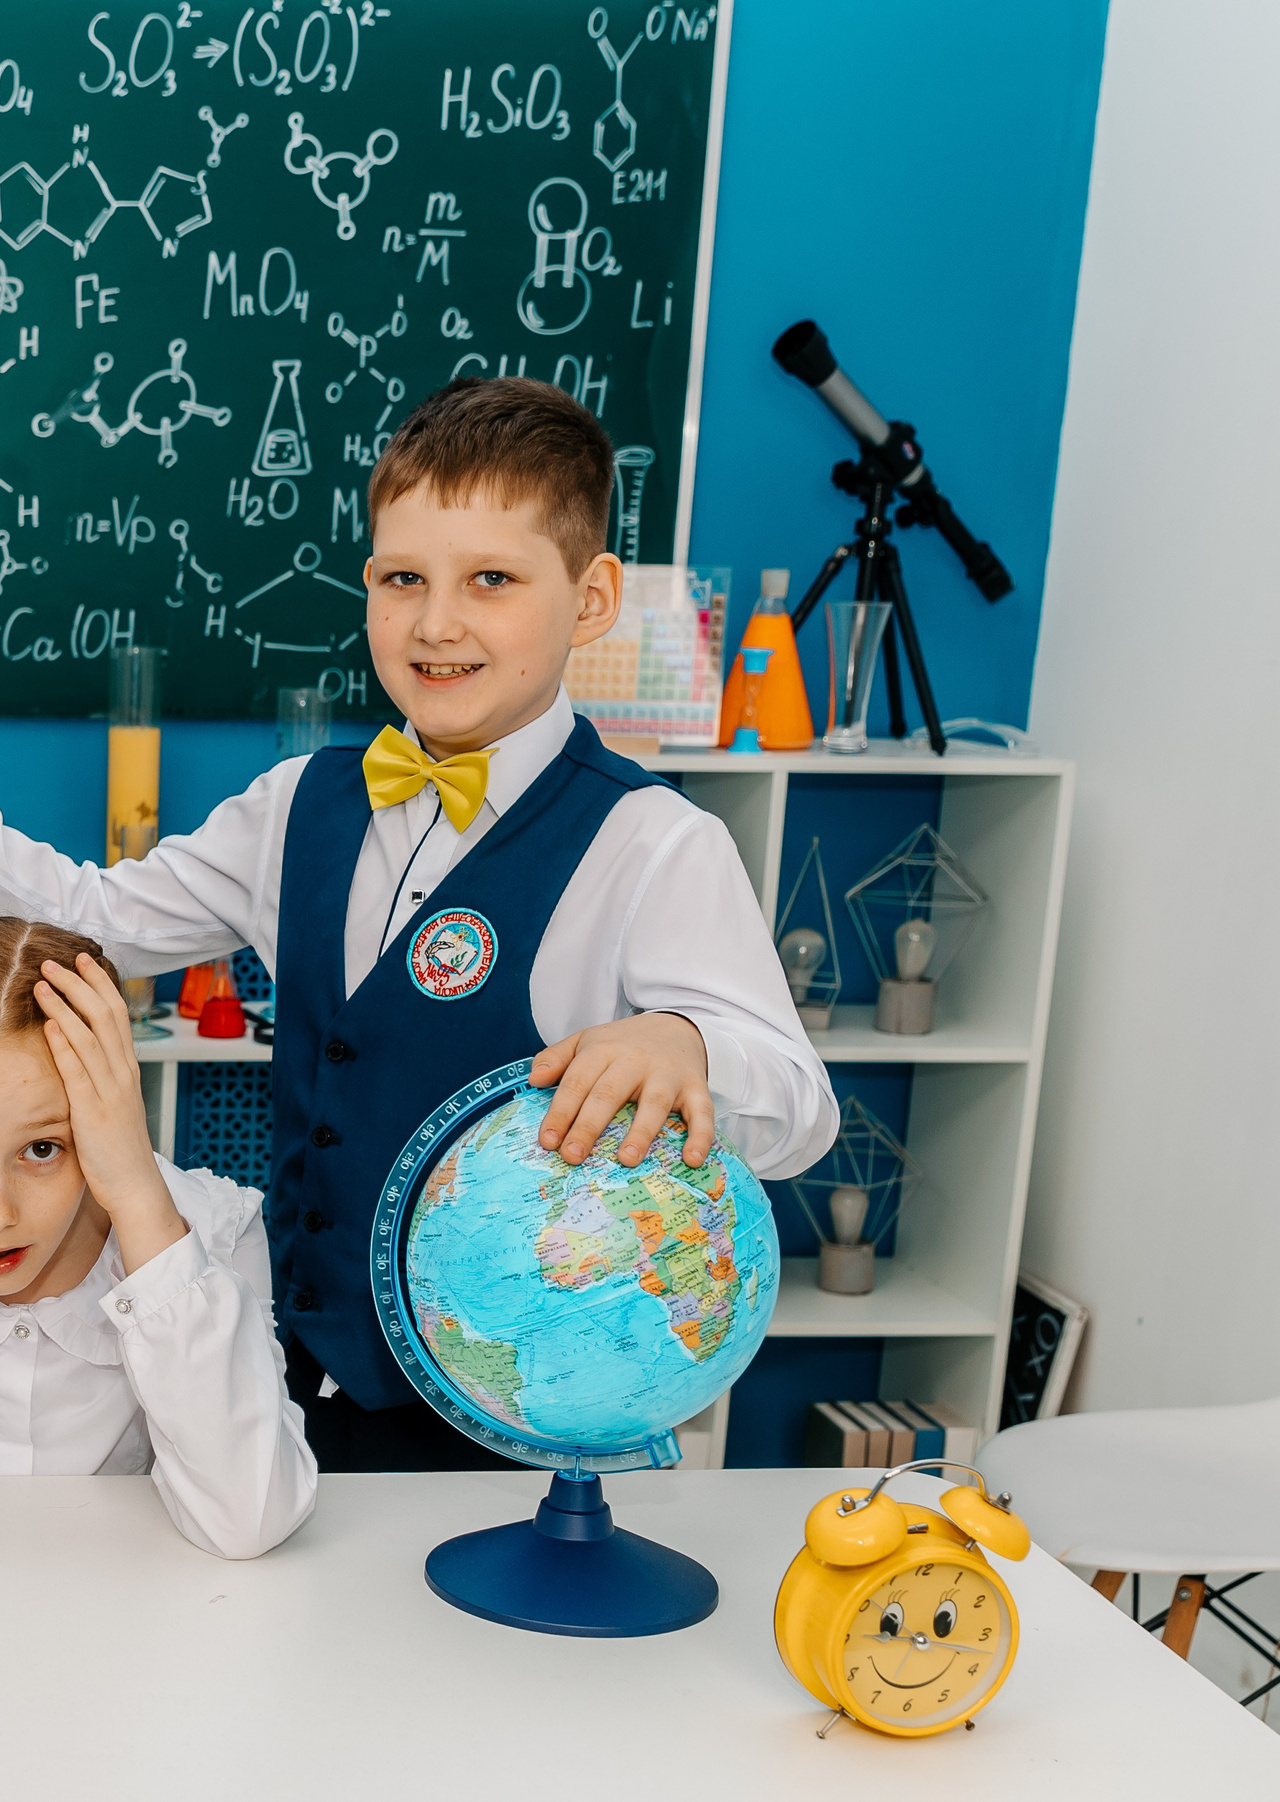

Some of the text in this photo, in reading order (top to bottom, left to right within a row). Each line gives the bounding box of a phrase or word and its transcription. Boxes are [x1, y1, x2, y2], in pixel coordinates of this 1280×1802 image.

[204, 247, 309, 323] MnO4
[75, 273, 120, 329] FE
[631, 280, 674, 328] Li
[440, 306, 474, 340] O2
[19, 326, 39, 360] H
[18, 495, 39, 528] H
[227, 477, 299, 526] H2O
[204, 604, 226, 638] H
[318, 667, 367, 706] OH
[914, 1563, 934, 1576] 12
[954, 1571, 963, 1584] 1
[973, 1595, 986, 1608] 2
[978, 1628, 992, 1642] 3
[847, 1666, 860, 1682] 8
[968, 1663, 980, 1676] 4
[870, 1690, 882, 1704] 7
[902, 1698, 914, 1712] 6
[937, 1689, 950, 1703] 5
